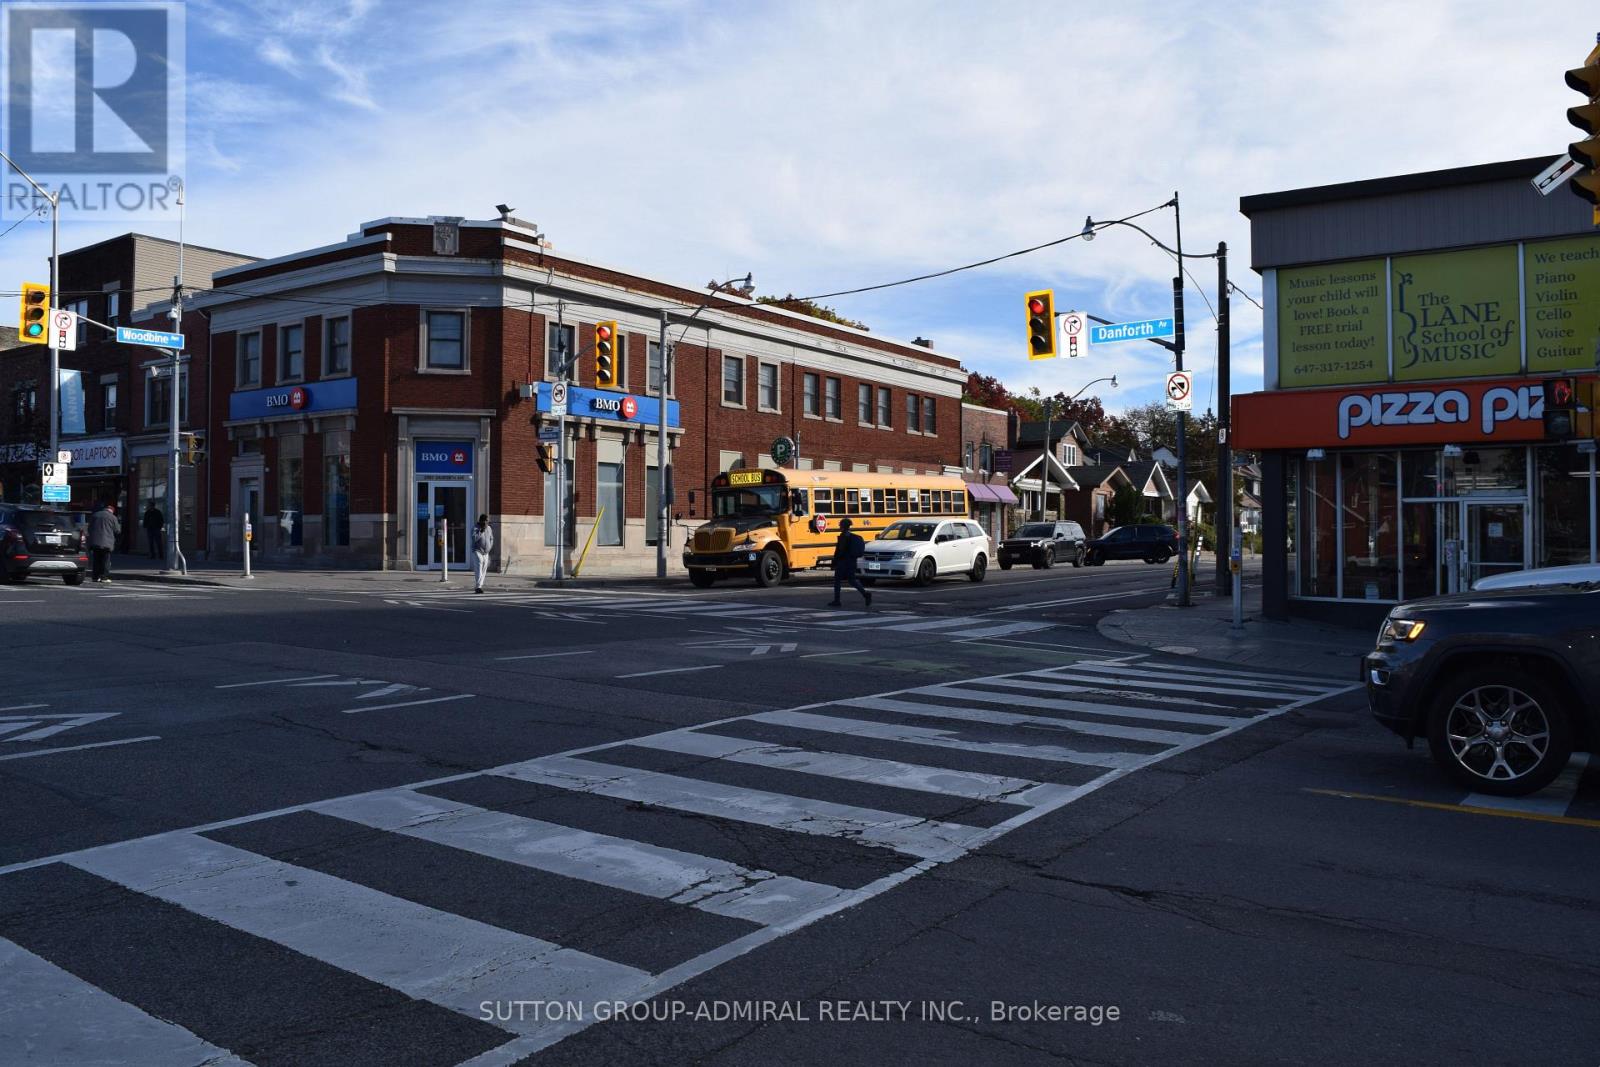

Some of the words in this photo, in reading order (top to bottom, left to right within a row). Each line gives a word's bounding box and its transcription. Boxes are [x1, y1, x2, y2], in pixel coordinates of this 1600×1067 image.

[1535, 252, 1556, 264] We
[1560, 247, 1599, 262] teach
[1289, 276, 1325, 289] Music
[1329, 272, 1376, 285] lessons
[1535, 272, 1576, 285] Piano
[1288, 295, 1316, 308] your
[1320, 288, 1351, 302] child
[1354, 286, 1378, 298] will
[1417, 292, 1450, 306] The
[1535, 288, 1578, 302] Violin
[1294, 309, 1323, 321] love!
[1327, 304, 1358, 317] Book
[1362, 306, 1369, 314] a
[1421, 301, 1501, 328] LANE
[1536, 307, 1572, 321] Cello
[1098, 323, 1154, 340] Danforth
[1300, 323, 1333, 336] FREE
[1336, 320, 1363, 332] trial
[1421, 325, 1485, 345] School
[1490, 320, 1515, 347] of
[1536, 327, 1575, 339] Voice
[123, 329, 169, 343] Woodbine
[1292, 340, 1331, 353] lesson
[1335, 336, 1375, 350] today!
[1537, 345, 1584, 358] Guitar
[1421, 342, 1496, 363] MUSIC
[1294, 360, 1374, 374] 647-317-1254
[266, 394, 289, 407] BMO
[595, 397, 620, 411] BMO
[1481, 385, 1545, 434] piz
[85, 446, 117, 461] LAPTOPS
[421, 452, 448, 461] BMO
[731, 473, 750, 483] SCHOOL
[751, 472, 761, 482] BUS
